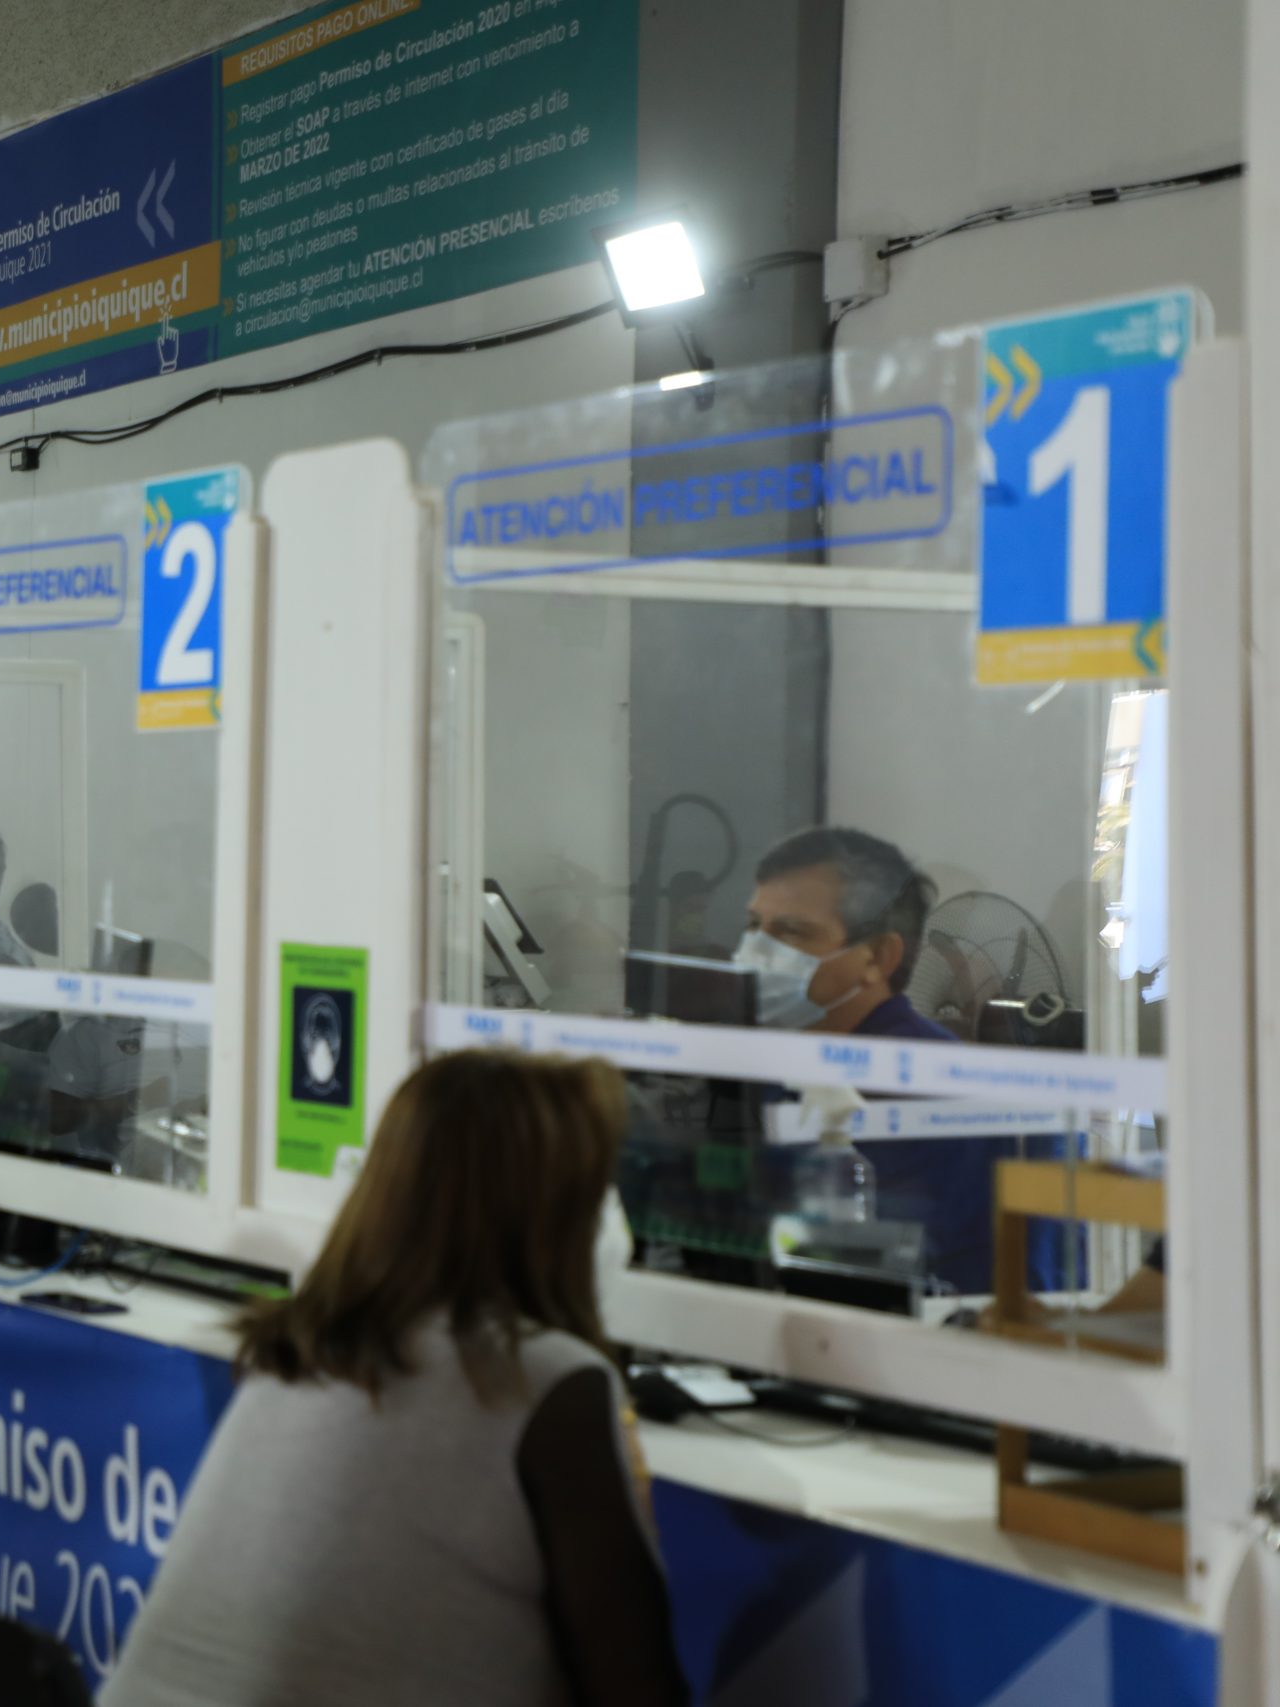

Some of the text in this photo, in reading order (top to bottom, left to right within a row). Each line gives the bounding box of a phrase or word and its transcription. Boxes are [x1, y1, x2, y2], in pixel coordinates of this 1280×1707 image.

[240, 28, 314, 75] REQUISITOS
[317, 11, 353, 43] PAGO
[240, 92, 289, 124] Registrar
[289, 80, 317, 109] pago
[319, 59, 372, 92] Permiso
[374, 50, 393, 71] de
[395, 19, 474, 64] Circulación
[477, 1, 511, 33] 2020
[240, 19, 580, 159] Obtener el SOAP a través de internet con vencimiento a
[238, 188, 283, 219] Revisión
[285, 175, 322, 204] técnica
[324, 159, 367, 189] vigente
[370, 151, 394, 173] con
[397, 126, 464, 164] certificado
[466, 119, 484, 142] de
[486, 105, 527, 140] gases
[529, 95, 543, 121] al
[238, 123, 591, 254] No figurar con deudas o multas relacionadas al tránsito de
[239, 131, 330, 184] MARZO DE 2022
[28, 241, 51, 273] 2021
[37, 211, 50, 238] de
[52, 188, 120, 232] Circulación
[236, 292, 248, 313] Si
[249, 280, 298, 307] necesitas
[299, 264, 345, 296] agendar
[347, 259, 361, 279] tu
[363, 234, 436, 275] ATENCIÓN
[439, 207, 535, 254] PRESENCIAL
[306, 225, 359, 259] peatones
[235, 266, 424, 337] a circulacion@municipioiquique.cl
[459, 449, 936, 548] ATENCIÓN PREFERENCIAL
[1028, 385, 1110, 625] 1
[155, 522, 217, 686] 2
[104, 1424, 177, 1557] de
